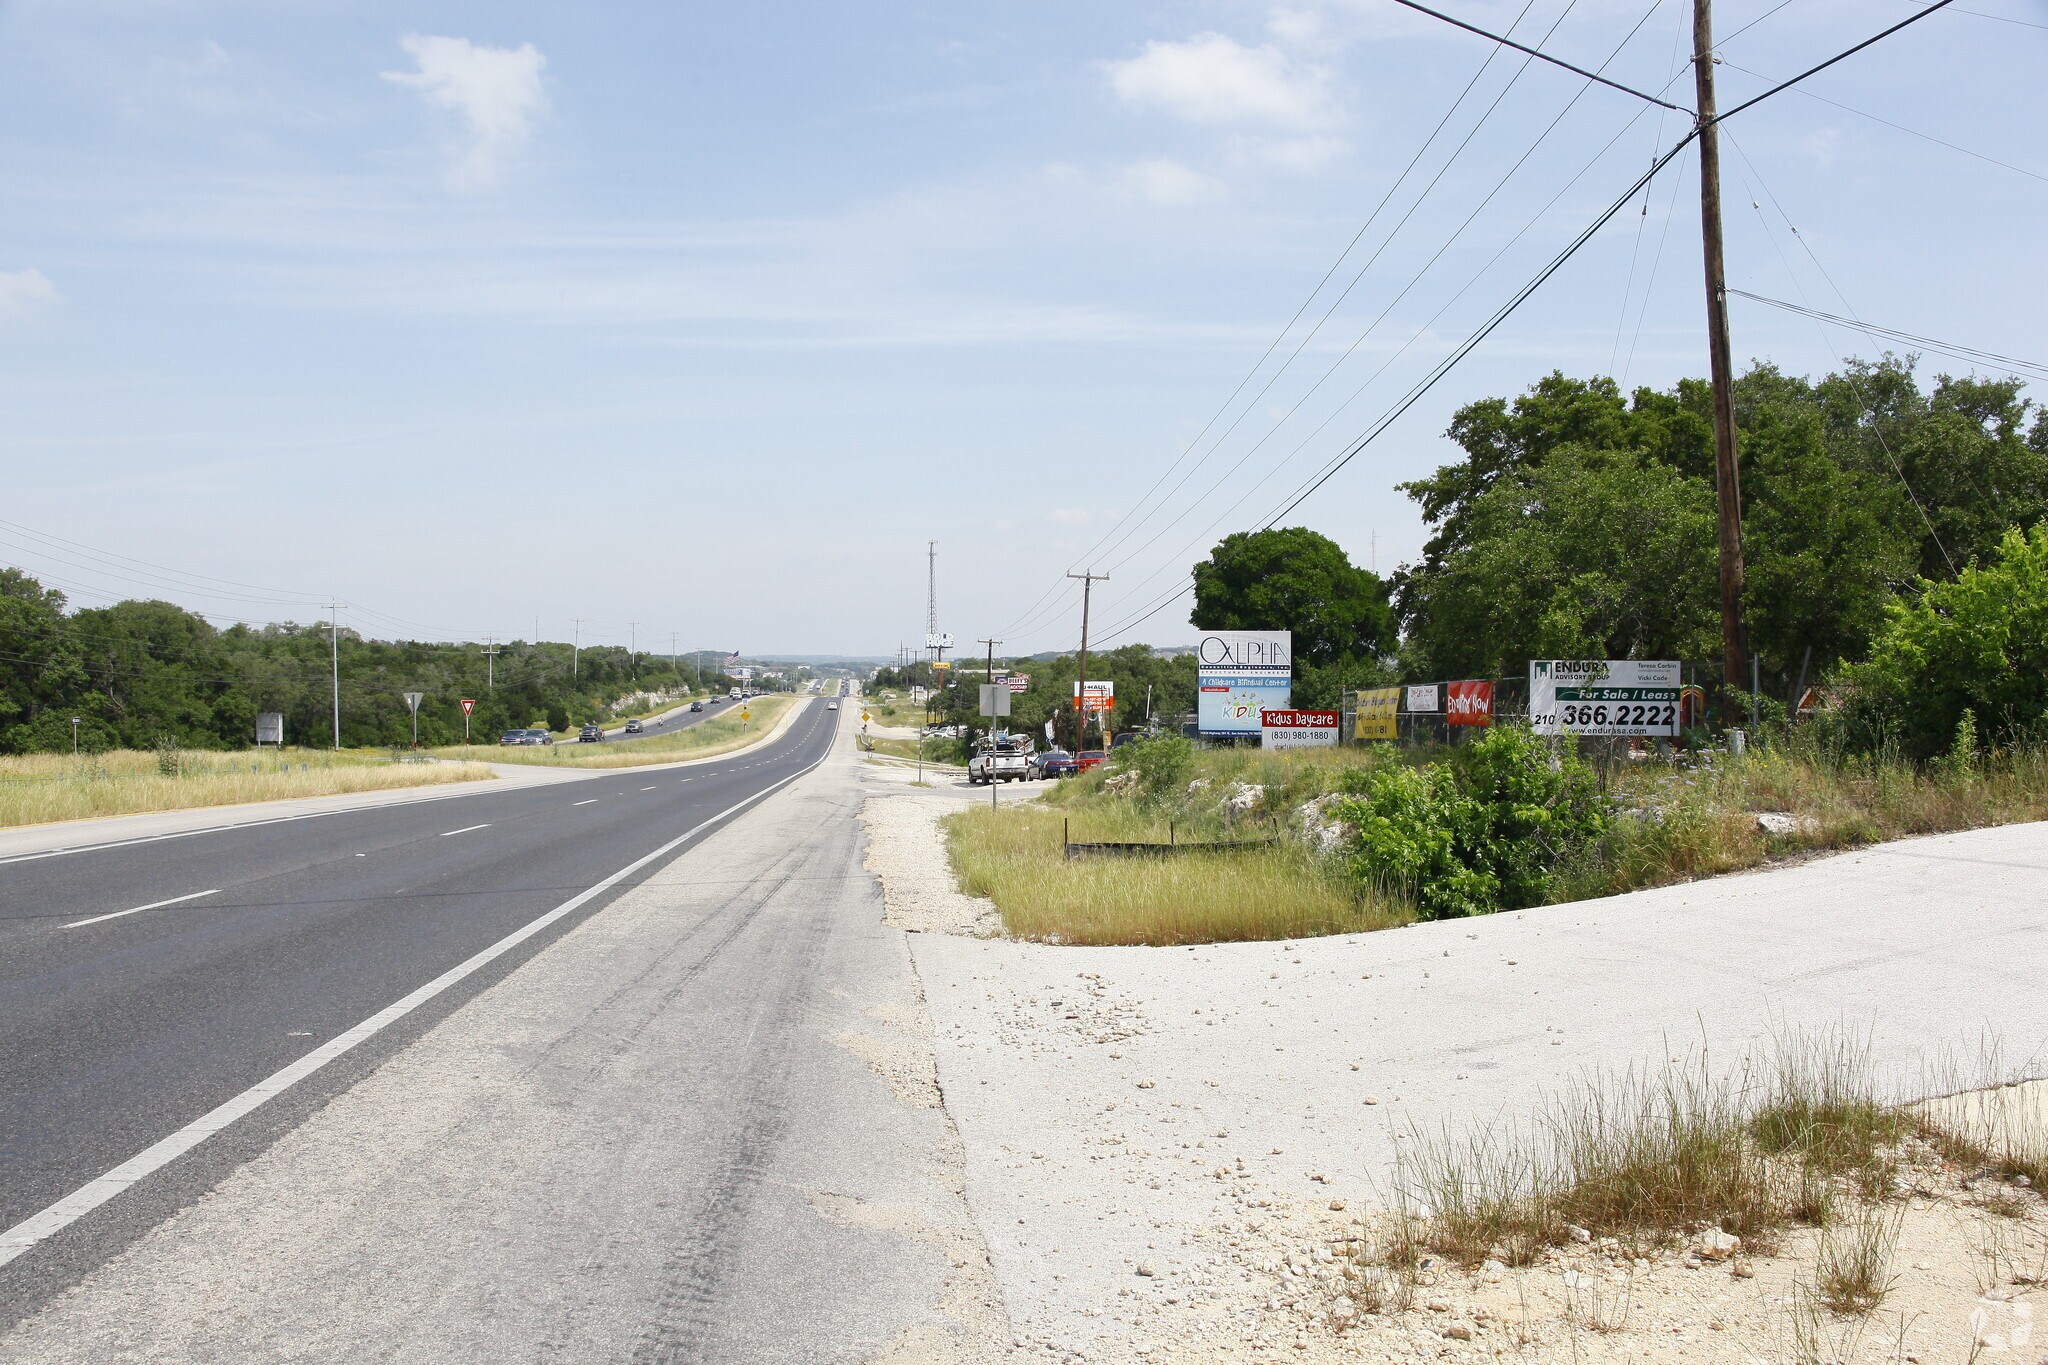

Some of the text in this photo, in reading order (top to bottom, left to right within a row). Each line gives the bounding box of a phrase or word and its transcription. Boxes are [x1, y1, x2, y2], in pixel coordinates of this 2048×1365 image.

[1555, 662, 1609, 672] ENDURA
[1208, 678, 1235, 686] Childcare
[1237, 678, 1263, 687] Bilingual
[1579, 689, 1676, 700] For Sale / Lease
[1266, 712, 1334, 727] Kidus Daycare
[1535, 704, 1676, 726] 210 366.2222
[1271, 731, 1291, 740] (830)
[1292, 731, 1329, 740] 980-1880
